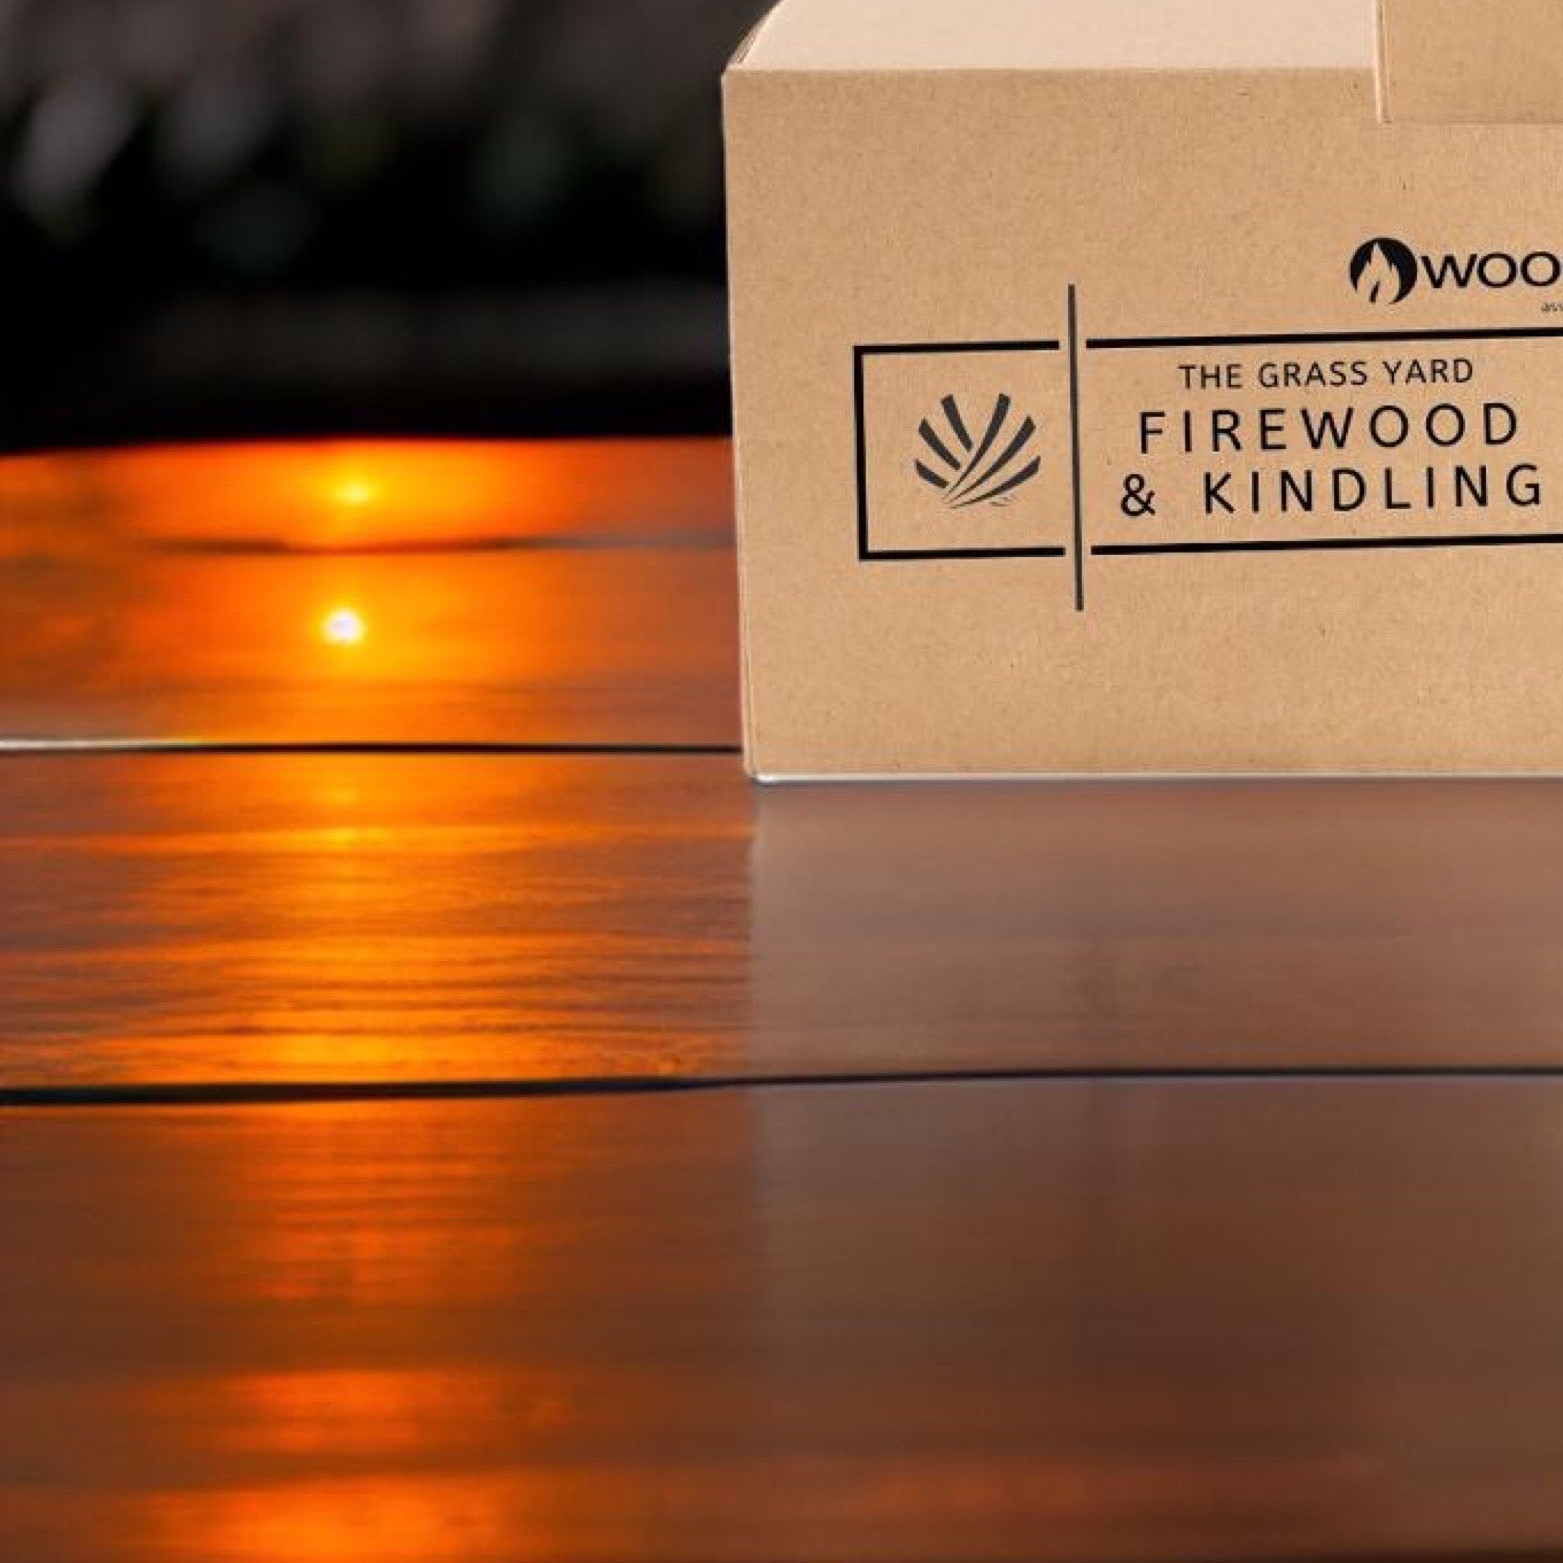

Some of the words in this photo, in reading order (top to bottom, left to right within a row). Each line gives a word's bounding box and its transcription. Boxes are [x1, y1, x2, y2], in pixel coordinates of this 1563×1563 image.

[1177, 363, 1243, 390] THE
[1257, 360, 1368, 389] GRASS
[1381, 357, 1473, 386] YARD
[1139, 402, 1517, 455] FIREWOOD
[1120, 473, 1156, 518] &
[1203, 462, 1541, 515] KINDLING
